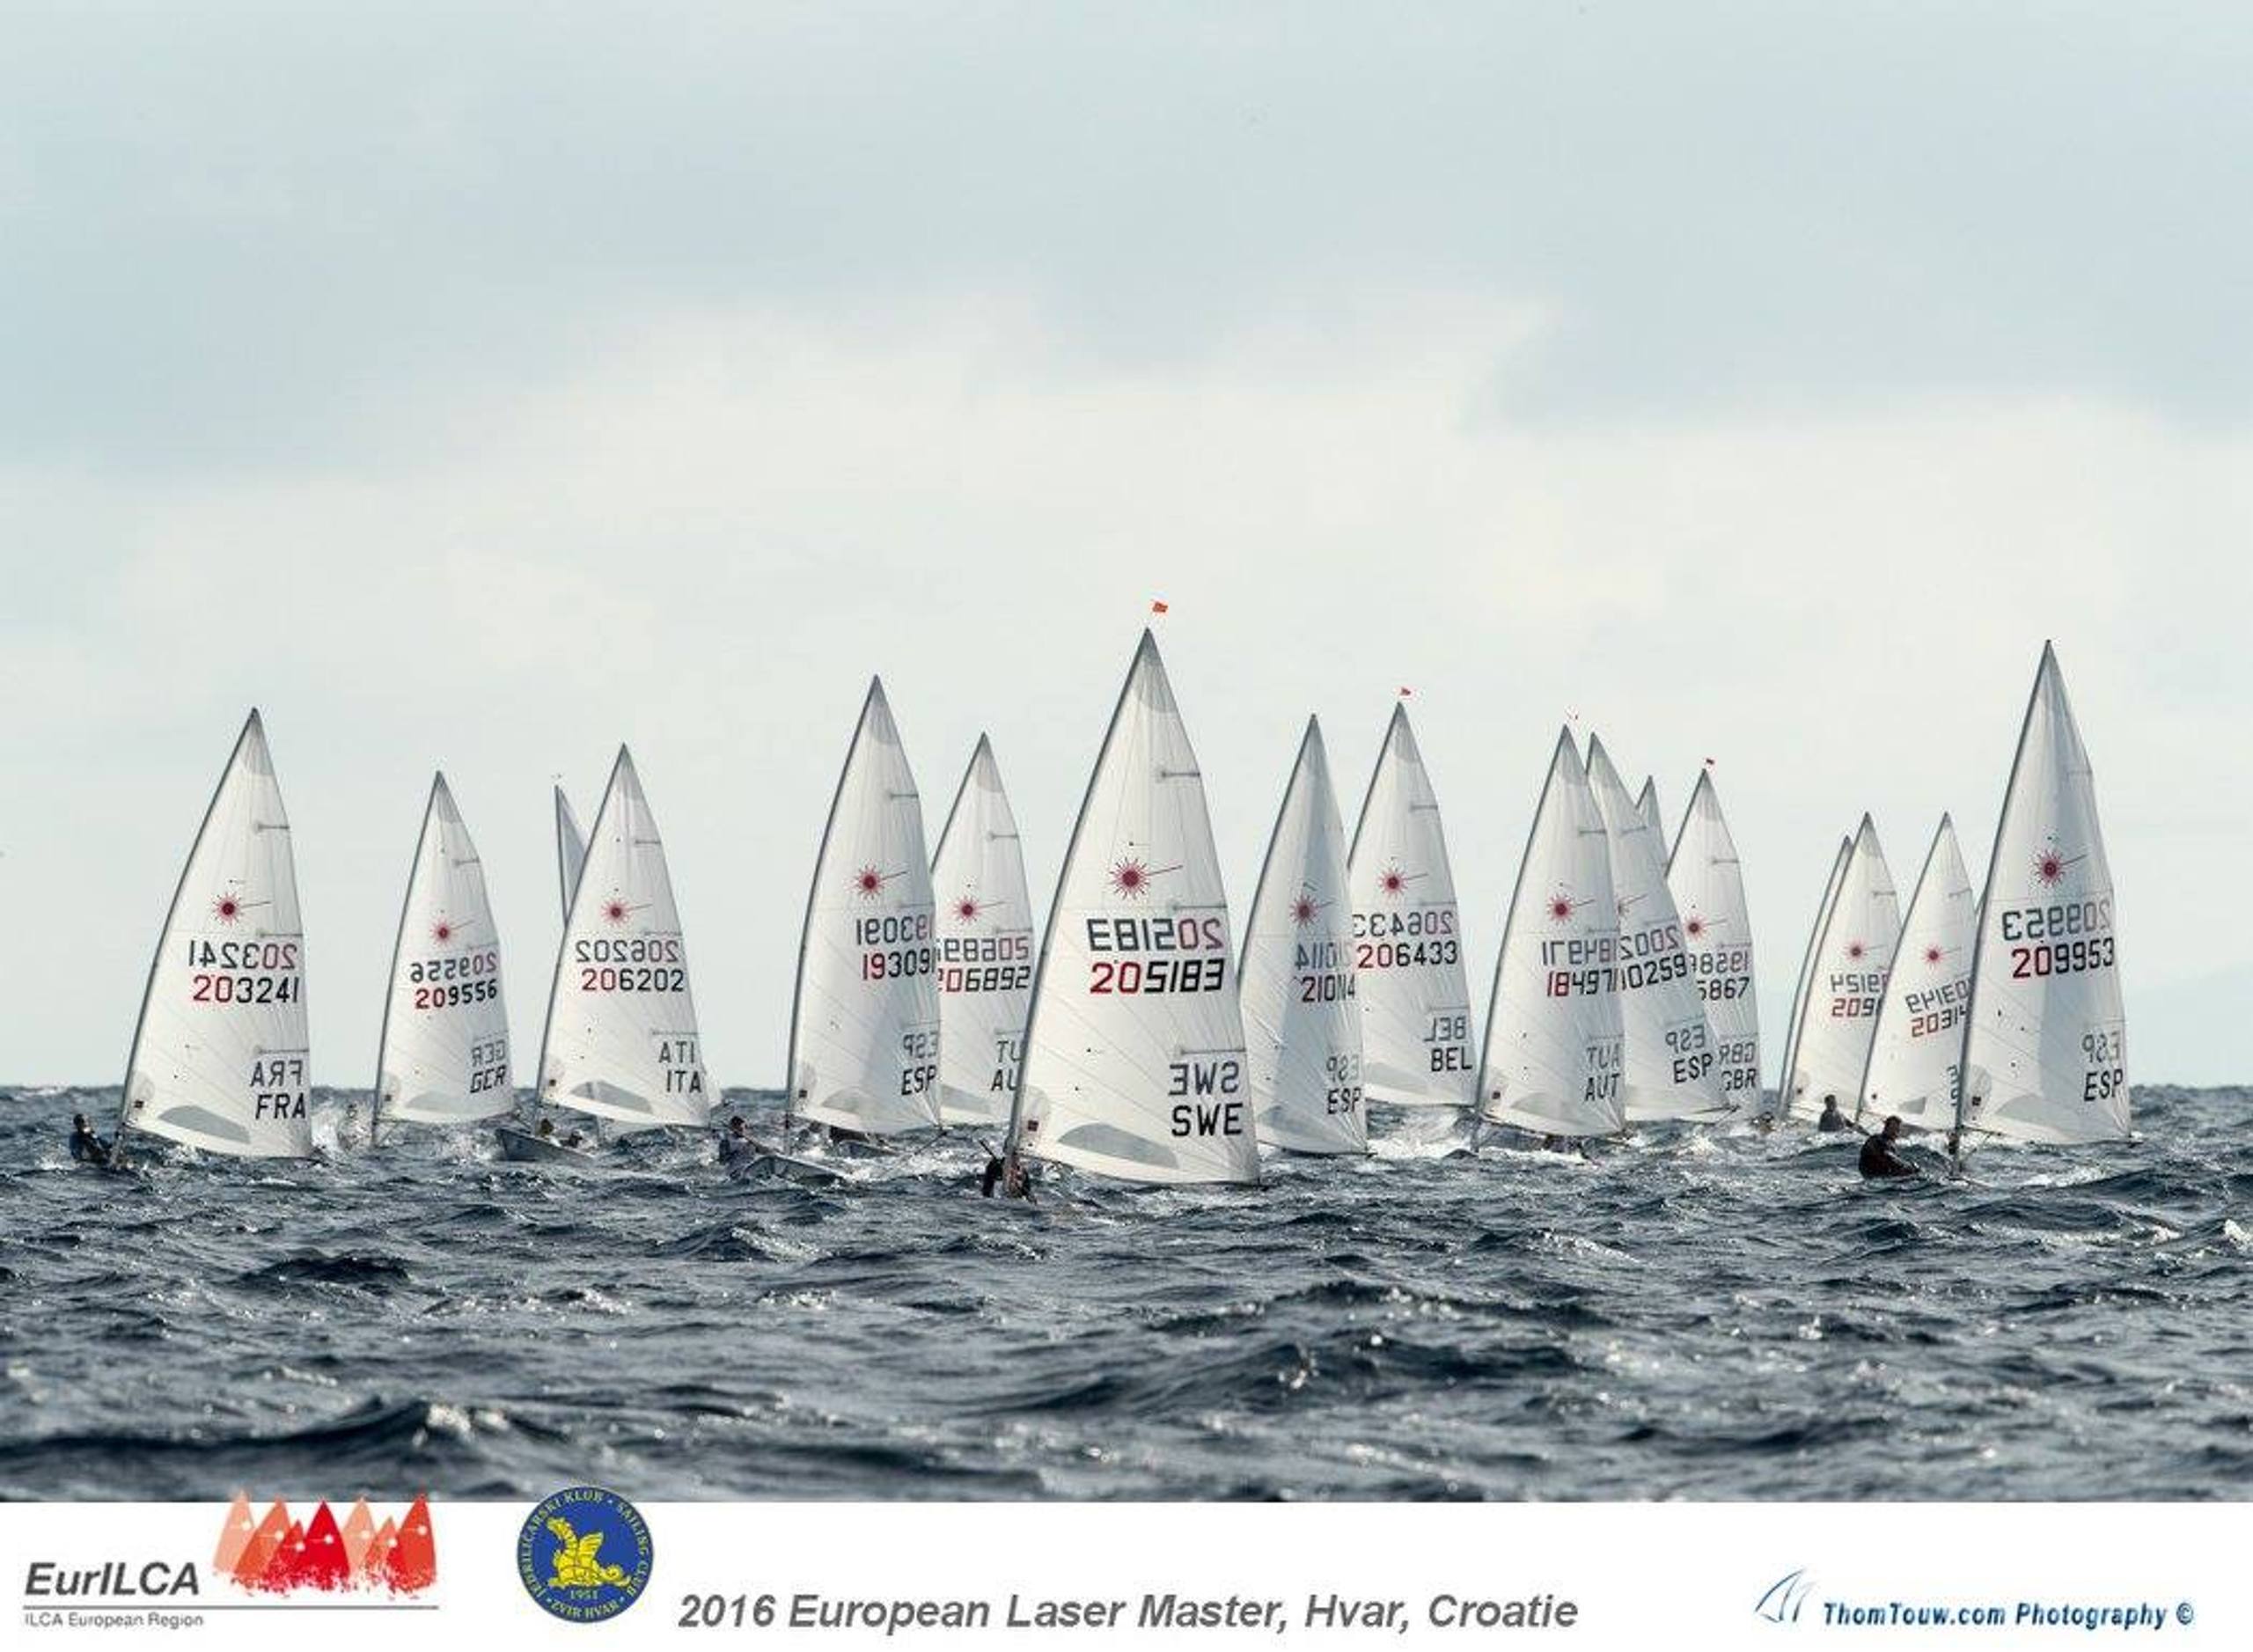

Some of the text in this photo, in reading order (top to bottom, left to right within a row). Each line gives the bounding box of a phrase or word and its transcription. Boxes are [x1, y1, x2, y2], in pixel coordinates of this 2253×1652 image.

[1356, 940, 1457, 968] 206433
[2012, 937, 2114, 979] 209953
[193, 974, 298, 1003] 203241
[582, 968, 684, 991] 206202
[1090, 958, 1225, 994] 205183
[1697, 977, 1750, 1001] 5867
[415, 979, 497, 1009] 209556
[1831, 998, 1875, 1017] 209
[1431, 1046, 1472, 1072] BEL
[1673, 1054, 1714, 1084] ESP
[470, 1065, 507, 1093] GER
[666, 1070, 701, 1093] ITA
[901, 1065, 937, 1095] ESP
[991, 1069, 1017, 1090] AU
[1585, 1073, 1620, 1100] AUT
[2084, 1069, 2123, 1102] ESP
[255, 1094, 306, 1119] FRA
[1327, 1087, 1361, 1114] ESP
[1171, 1103, 1243, 1136] SWE
